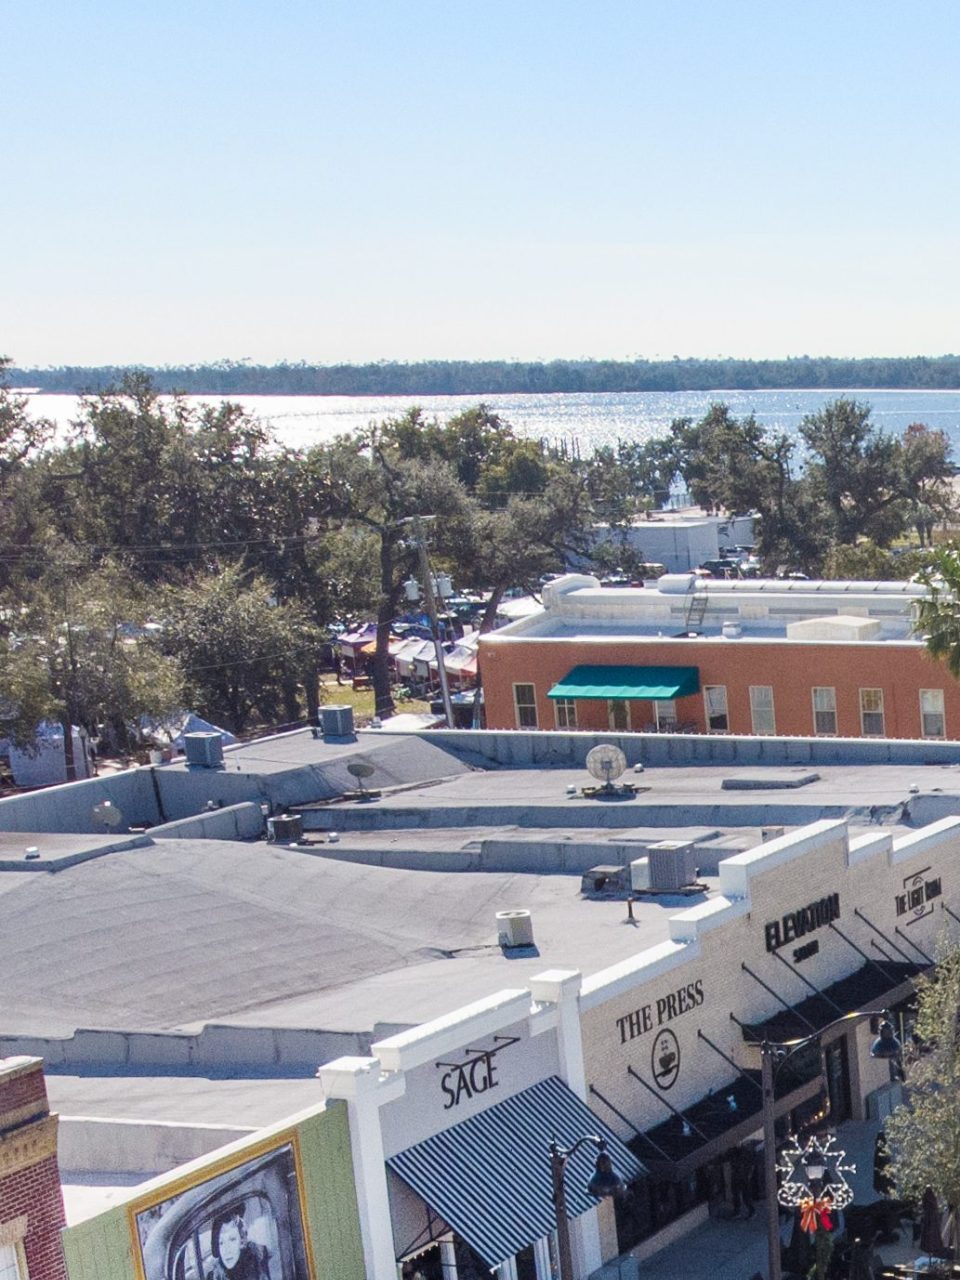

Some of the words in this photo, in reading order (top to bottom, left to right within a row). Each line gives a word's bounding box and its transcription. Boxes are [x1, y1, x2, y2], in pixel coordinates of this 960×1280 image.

[765, 892, 840, 953] ELEVATION
[616, 1004, 653, 1045] THE
[656, 979, 704, 1026] PRESS
[441, 1053, 498, 1110] SAGE
